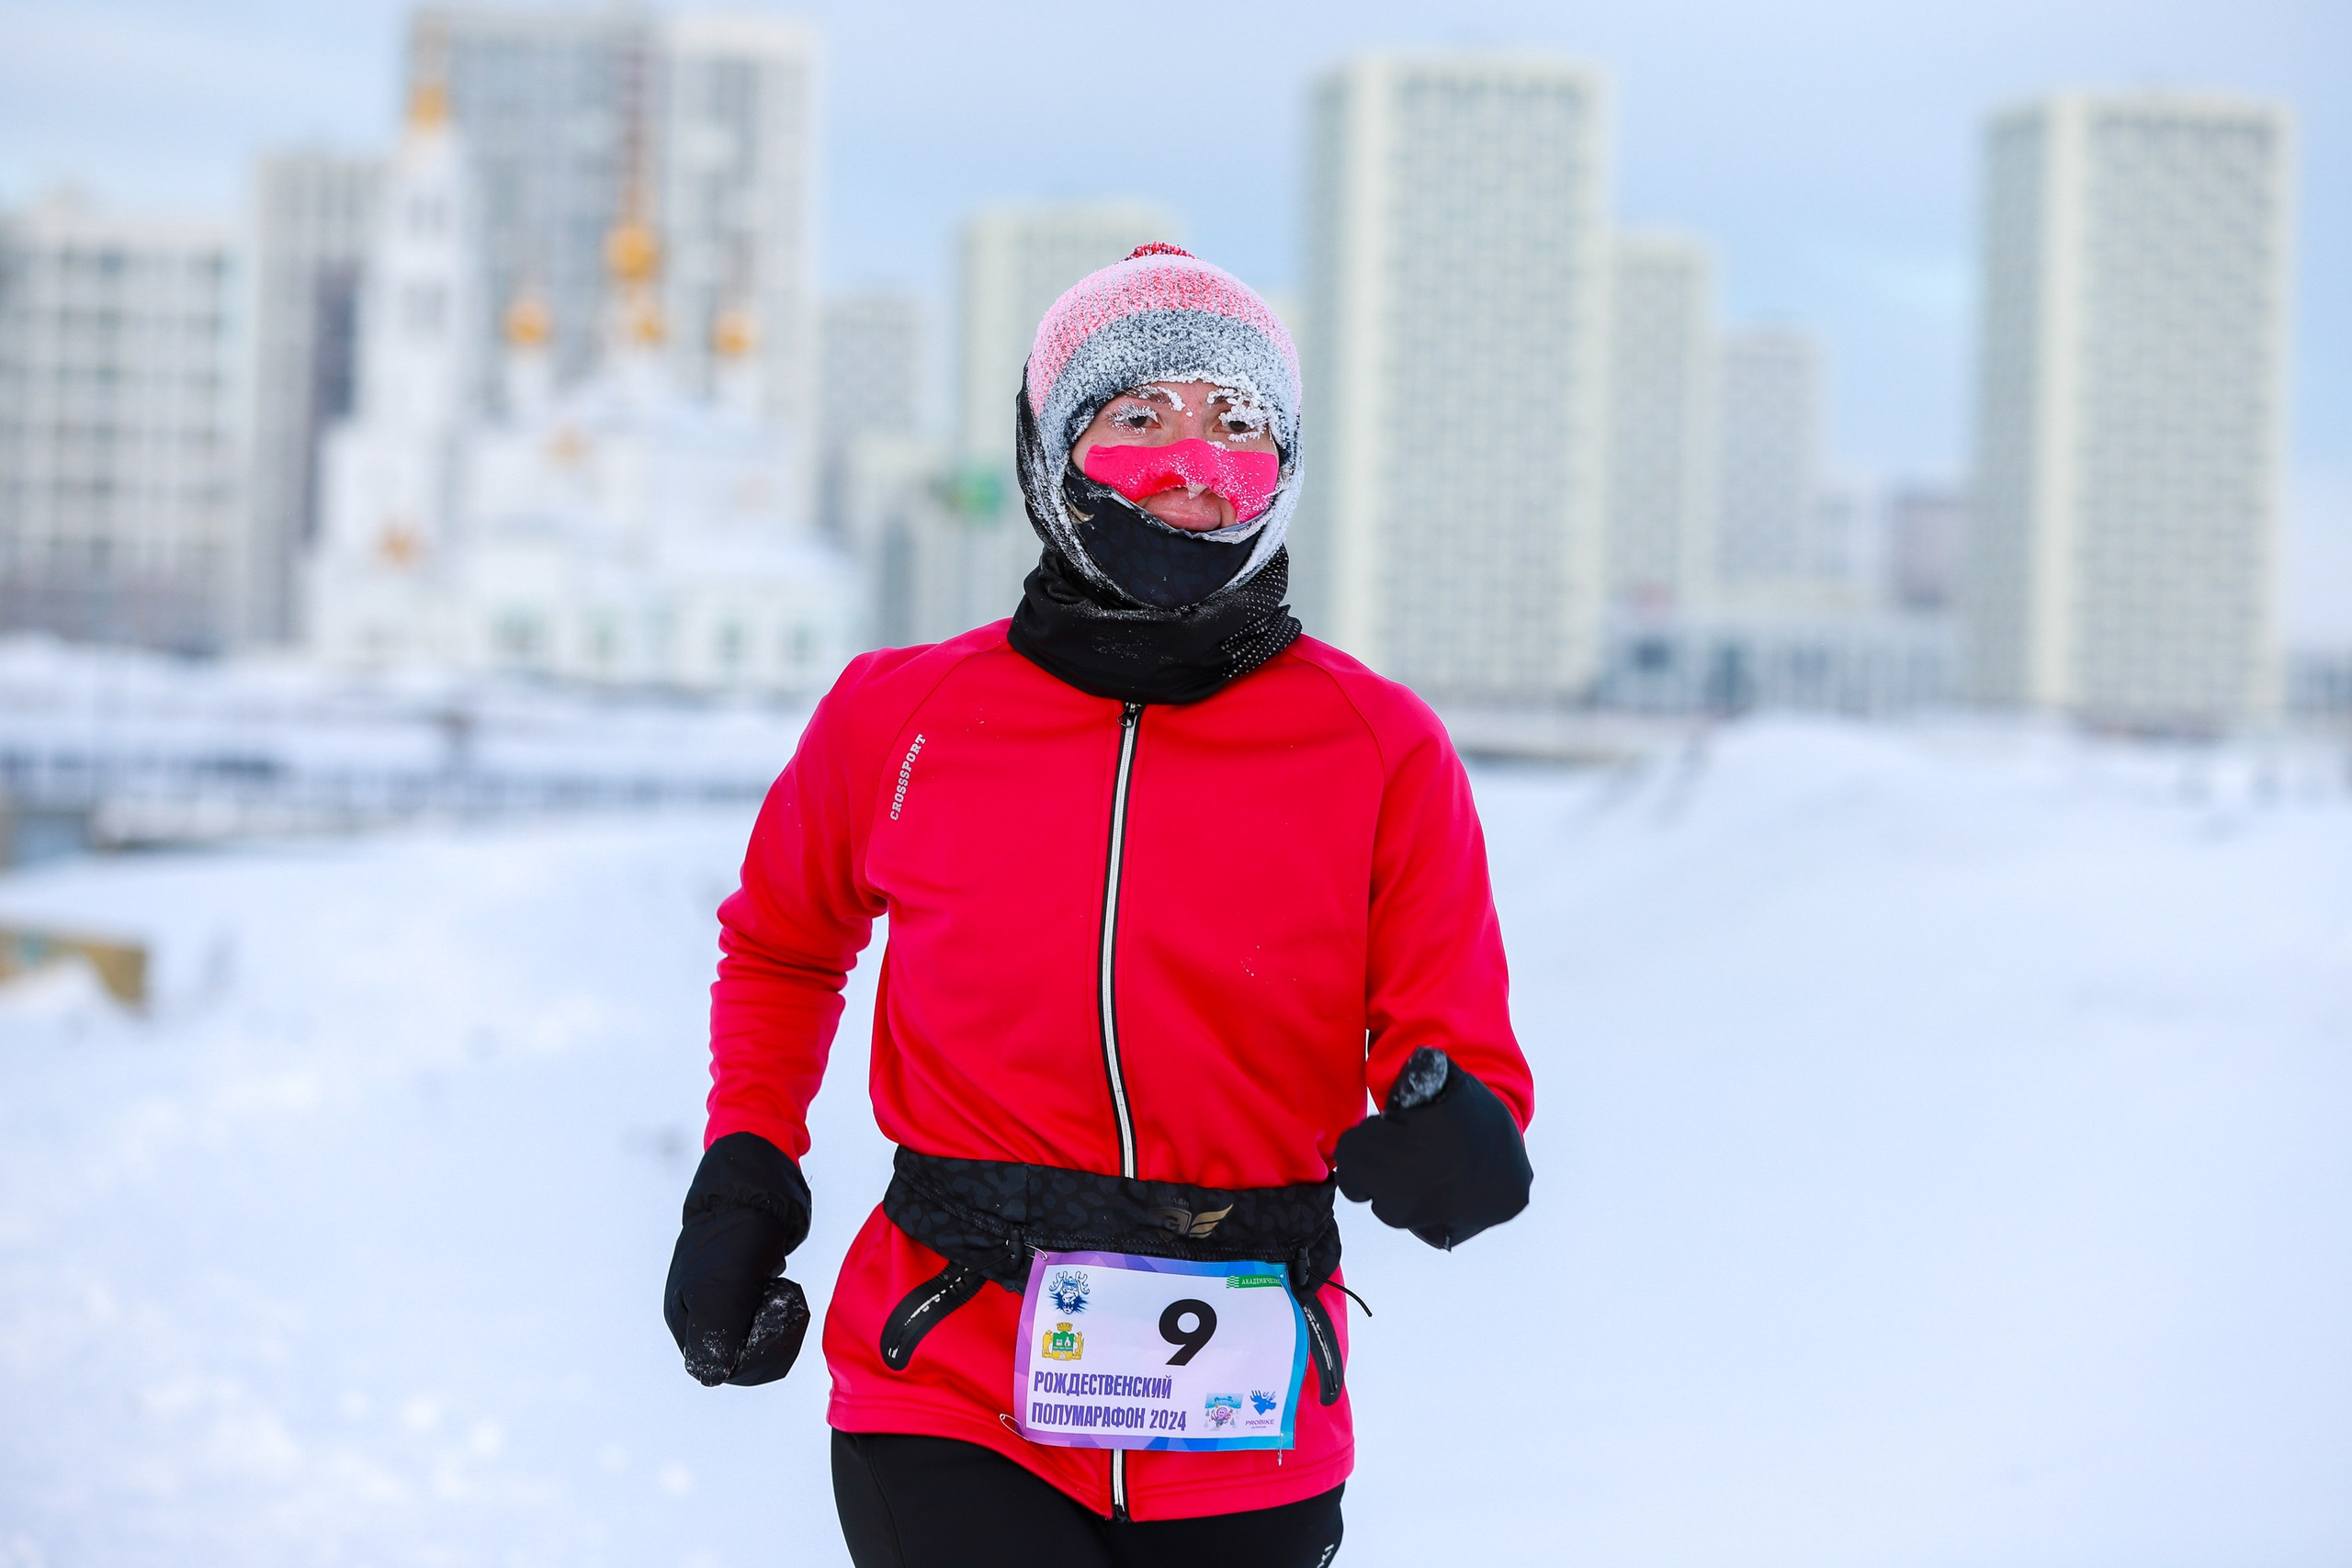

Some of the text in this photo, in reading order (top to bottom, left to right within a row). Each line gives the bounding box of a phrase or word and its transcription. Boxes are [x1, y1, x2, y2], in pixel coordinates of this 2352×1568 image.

[889, 733, 926, 820] CROSSSPORT
[1159, 1298, 1217, 1366] 9
[1034, 1371, 1172, 1399] РОЖДЕСТВЕНСКИЙ
[1031, 1402, 1187, 1431] ПОЛУМАРАФОН 2024
